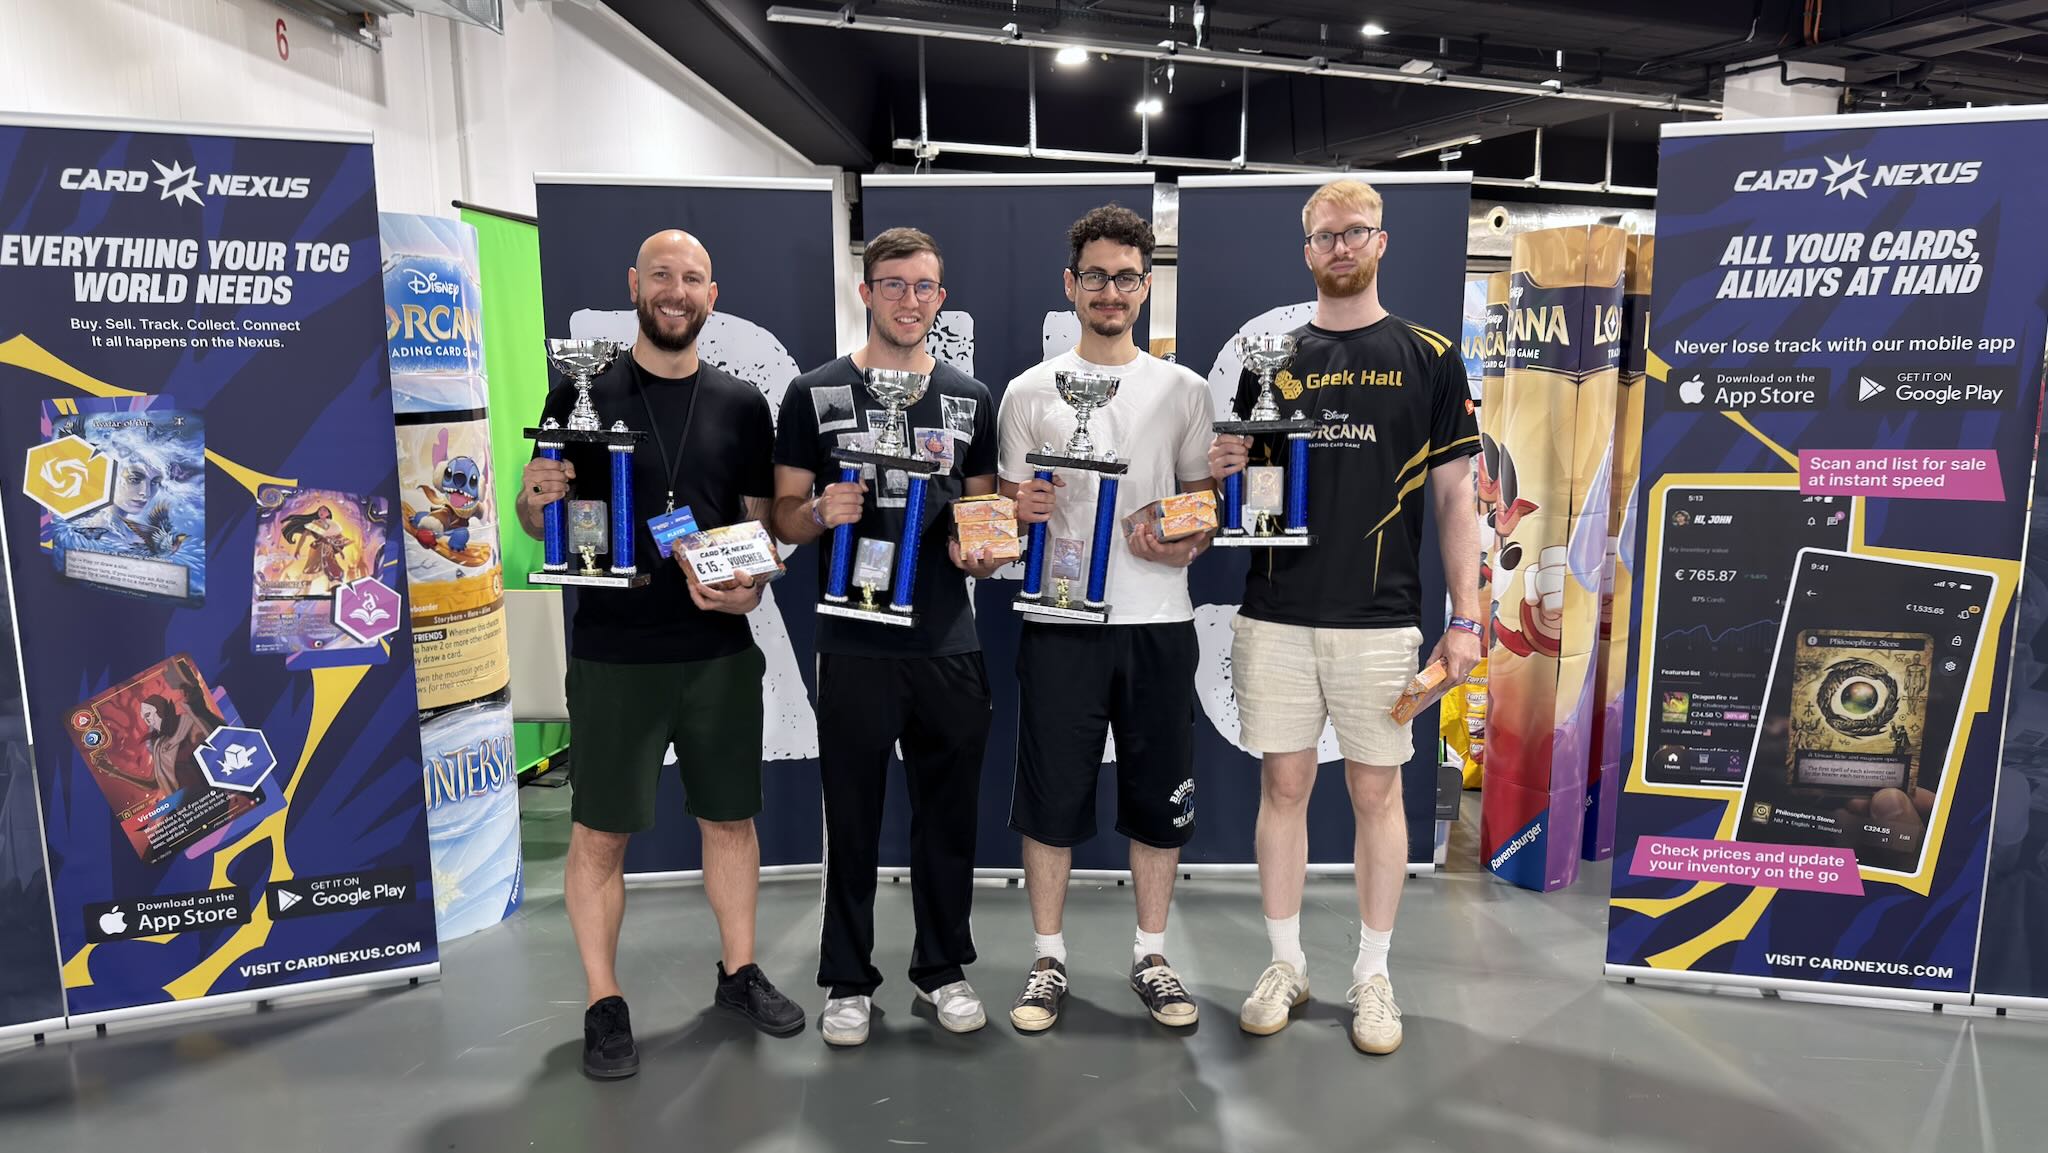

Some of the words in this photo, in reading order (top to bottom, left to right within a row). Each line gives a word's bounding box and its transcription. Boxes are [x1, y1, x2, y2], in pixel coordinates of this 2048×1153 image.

[276, 18, 289, 60] 6
[60, 168, 148, 192] CARD
[207, 174, 310, 198] NEXUS
[1734, 168, 1818, 192] CARD
[1872, 162, 1983, 187] NEXUS
[1, 235, 198, 270] EVERYTHING
[207, 240, 286, 271] YOUR
[294, 242, 350, 272] TCG
[1719, 236, 1774, 266] ALL
[1784, 233, 1865, 264] YOUR
[1868, 229, 1981, 264] CARDS,
[73, 272, 188, 303] WORLD
[196, 275, 293, 305] NEEDS
[1716, 266, 1842, 299] ALWAYS
[1845, 266, 1890, 296] AT
[1891, 264, 1984, 295] HAND
[70, 318, 102, 331] Buy.
[105, 318, 136, 330] Sell.
[139, 318, 184, 331] Track.
[186, 319, 240, 331] Collect.
[242, 320, 301, 332] Connect
[92, 336, 102, 346] It
[105, 336, 122, 347] all
[125, 336, 187, 350] happens
[190, 339, 208, 347] on
[211, 337, 234, 348] the
[237, 337, 285, 349] Nexus.
[391, 346, 433, 358] ADING
[435, 346, 461, 357] CARD
[1674, 339, 1728, 354] Never
[1732, 339, 1770, 354] lose
[1774, 338, 1823, 353] track
[1827, 338, 1867, 352] with
[1871, 339, 1906, 352] our
[1908, 336, 1972, 352] mobile
[1978, 338, 2016, 354] app
[1517, 349, 1541, 360] GAME
[1306, 370, 1355, 389] Geek
[1360, 370, 1403, 387] Hall
[1716, 374, 1774, 384] Download
[1777, 375, 1793, 383] on
[1795, 373, 1816, 383] the
[1897, 373, 1918, 382] GET
[1921, 373, 1929, 381] IT
[1932, 373, 1952, 381] ON
[1714, 387, 1757, 408] App
[1760, 386, 1815, 404] Store
[1895, 385, 1962, 406] Google
[1965, 386, 2004, 405] Play
[1809, 457, 1853, 472] Scan
[1856, 457, 1888, 471] and
[1891, 457, 1919, 471] list
[1922, 457, 1947, 471] for
[1950, 457, 1986, 472] sale
[1808, 474, 1825, 487] at
[1829, 473, 1888, 487] instant
[1892, 474, 1946, 490] speed
[1708, 515, 1734, 525] JOHN
[696, 563, 706, 575] €
[727, 551, 765, 567] VOUCHER
[699, 550, 720, 559] CARD
[1675, 569, 1685, 581] €
[1688, 569, 1737, 582] 765.87
[1811, 562, 1830, 572] 9:41
[413, 631, 444, 643] FRIENDS
[421, 643, 437, 653] have
[440, 641, 444, 650] 2
[423, 653, 440, 664] draw
[1661, 669, 1690, 677] Featured
[1692, 693, 1716, 701] Dragon
[137, 802, 171, 823] Virtuoso
[1775, 808, 1816, 821] Philosopher's
[1816, 815, 1836, 825] Stone
[1491, 822, 1542, 871] Ravensburger
[1650, 843, 1700, 858] Check
[1703, 846, 1751, 864] prices
[1754, 850, 1784, 863] and
[1788, 852, 1845, 871] update
[1649, 859, 1684, 872] your
[1687, 859, 1760, 879] inventory
[1764, 866, 1785, 878] on
[1789, 866, 1814, 880] the
[1818, 870, 1839, 885] go
[311, 880, 331, 891] GET
[333, 879, 341, 889] IT
[343, 877, 360, 888] ON
[137, 897, 195, 912] Download
[199, 898, 214, 907] on
[217, 892, 235, 905] the
[311, 888, 372, 908] Google
[374, 884, 407, 903] Play
[138, 913, 182, 933] App
[184, 906, 238, 925] Store
[240, 961, 281, 978] VISIT
[284, 941, 421, 972] CARDNEXUS.COM
[1765, 953, 1806, 967] VISIT
[1809, 957, 1953, 979] CARDNEXUS.COM
